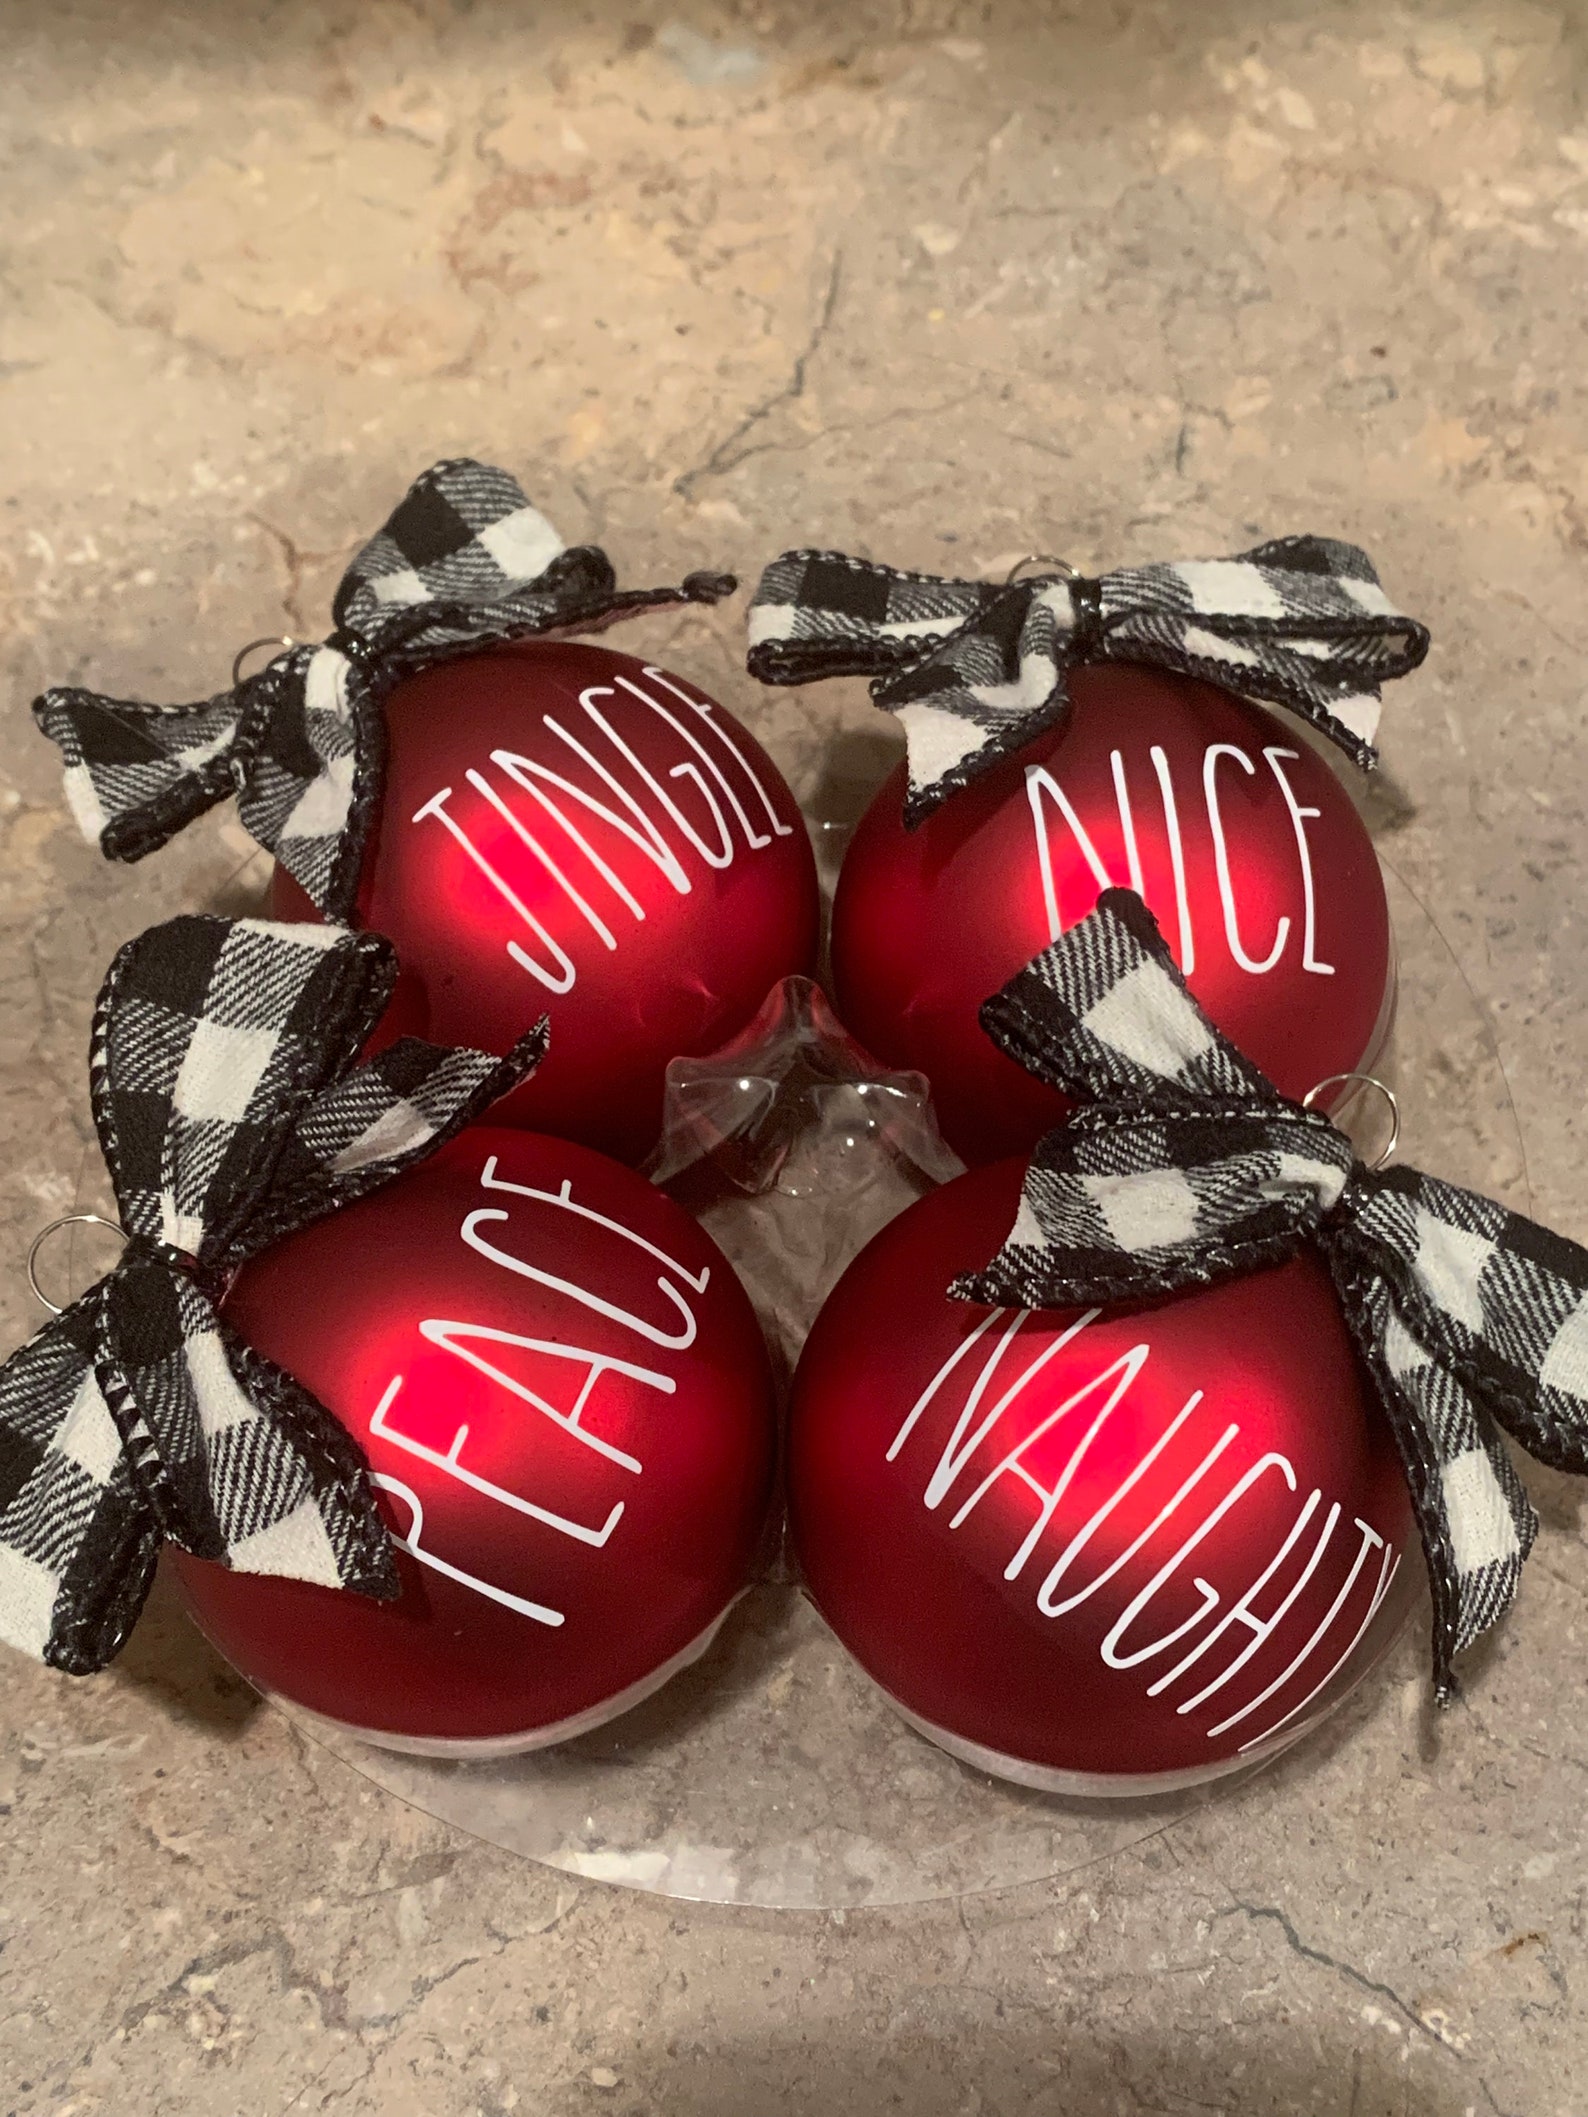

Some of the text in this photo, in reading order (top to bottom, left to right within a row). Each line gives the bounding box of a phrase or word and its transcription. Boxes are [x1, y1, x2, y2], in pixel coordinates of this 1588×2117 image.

[412, 667, 793, 994] JINGLE
[1024, 744, 1336, 976] NICE
[366, 1155, 710, 1627] PEACE
[886, 1307, 1401, 1752] NAUGHTY
